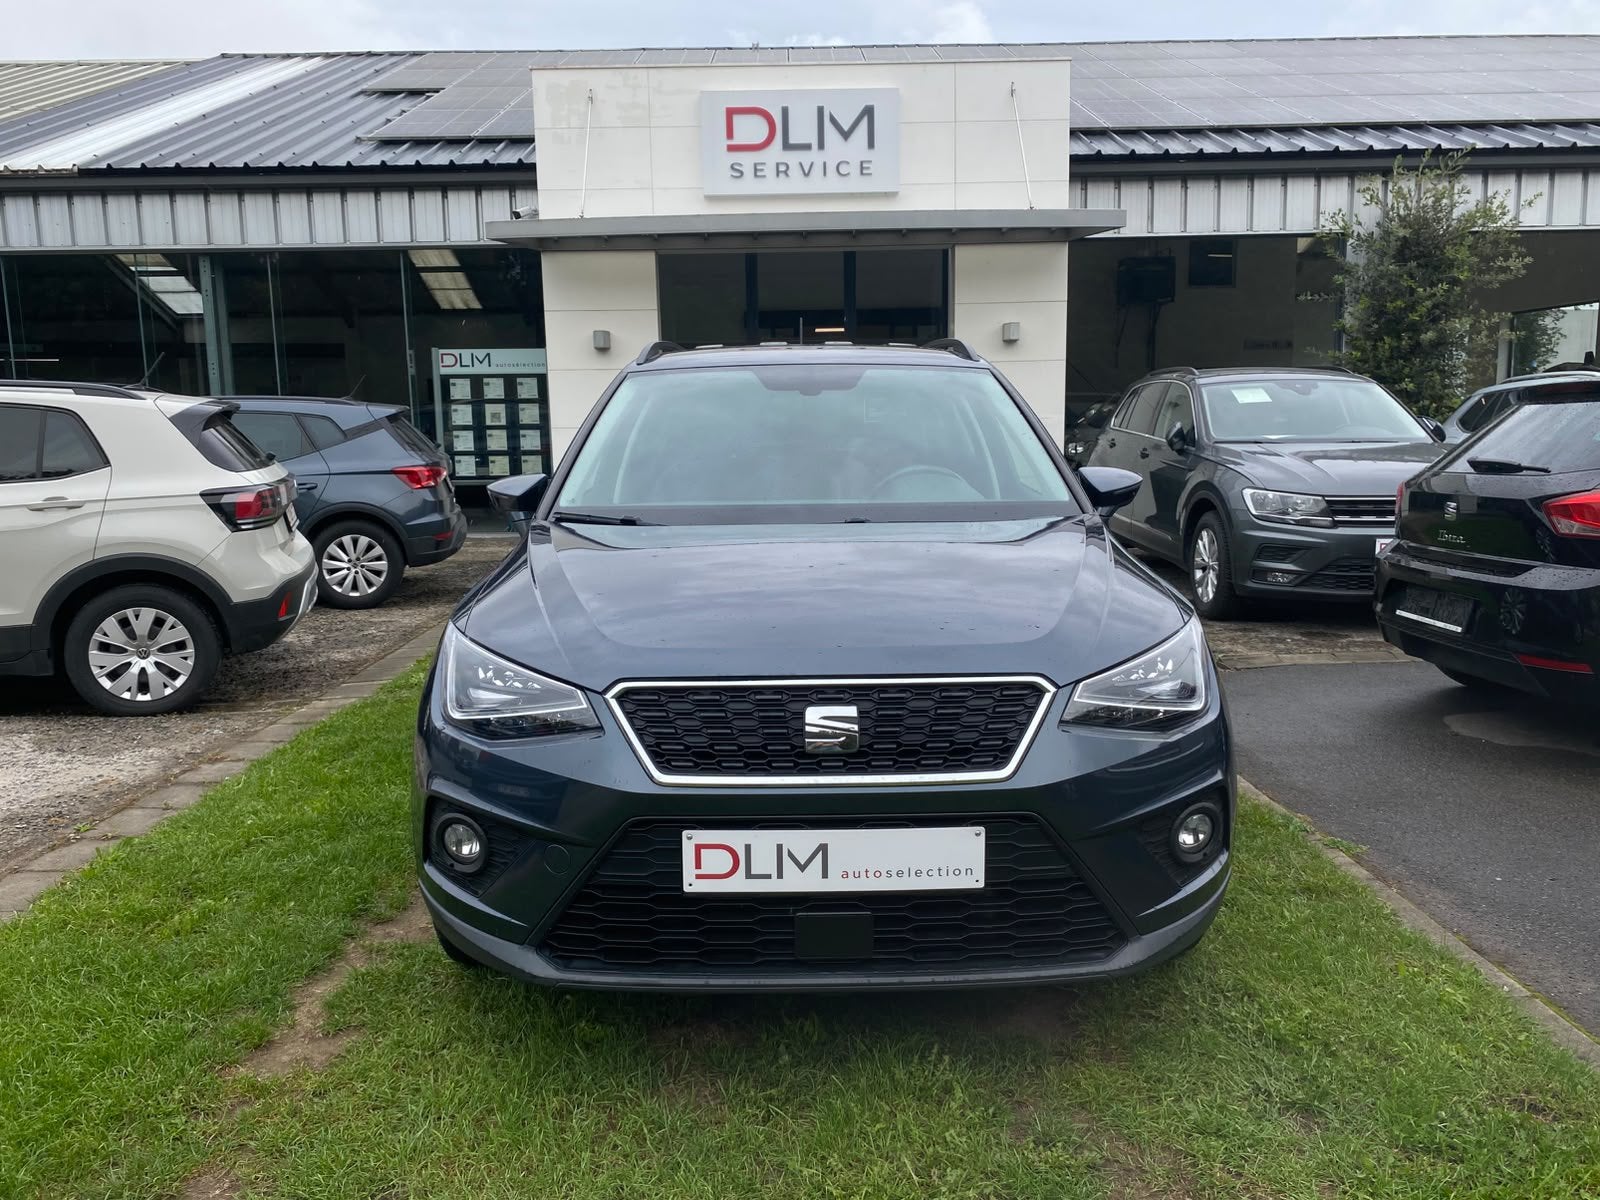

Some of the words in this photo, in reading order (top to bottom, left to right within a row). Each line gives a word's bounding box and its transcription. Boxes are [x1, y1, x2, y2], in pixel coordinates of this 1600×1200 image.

[725, 104, 875, 152] DLM
[730, 160, 873, 179] SERVICE
[440, 352, 492, 368] DLM
[694, 842, 828, 880] DLM
[841, 865, 974, 879] autoselection
